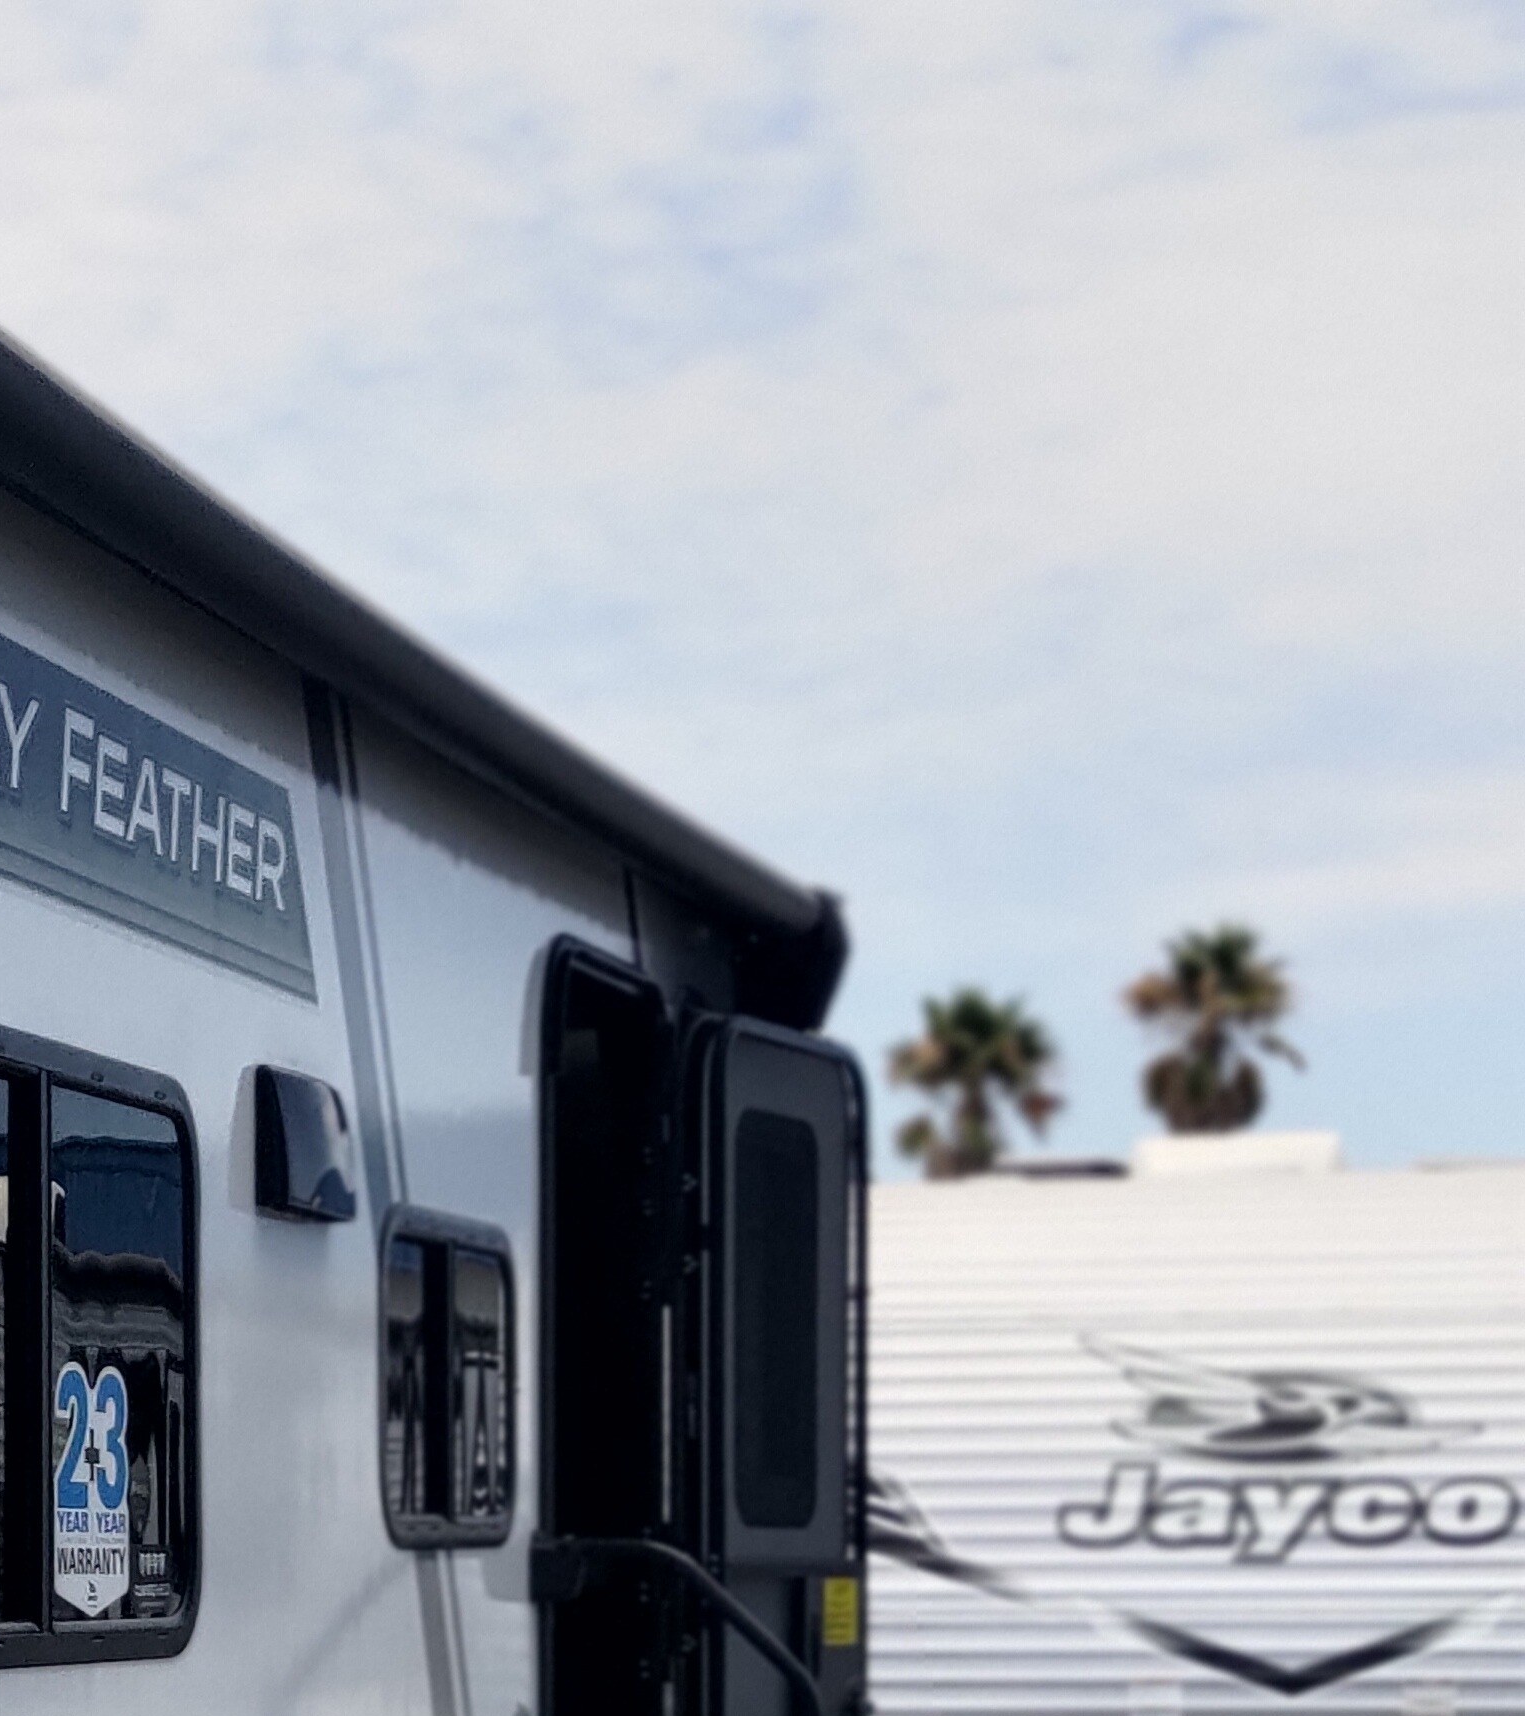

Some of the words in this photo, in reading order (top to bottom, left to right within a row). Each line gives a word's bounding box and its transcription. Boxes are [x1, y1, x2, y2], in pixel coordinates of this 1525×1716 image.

[59, 707, 286, 911] FEATHER
[57, 1511, 89, 1533] YEAR
[96, 1512, 126, 1534] YEAR
[1055, 1460, 1523, 1565] Jayco
[57, 1547, 127, 1575] WARRANTY
